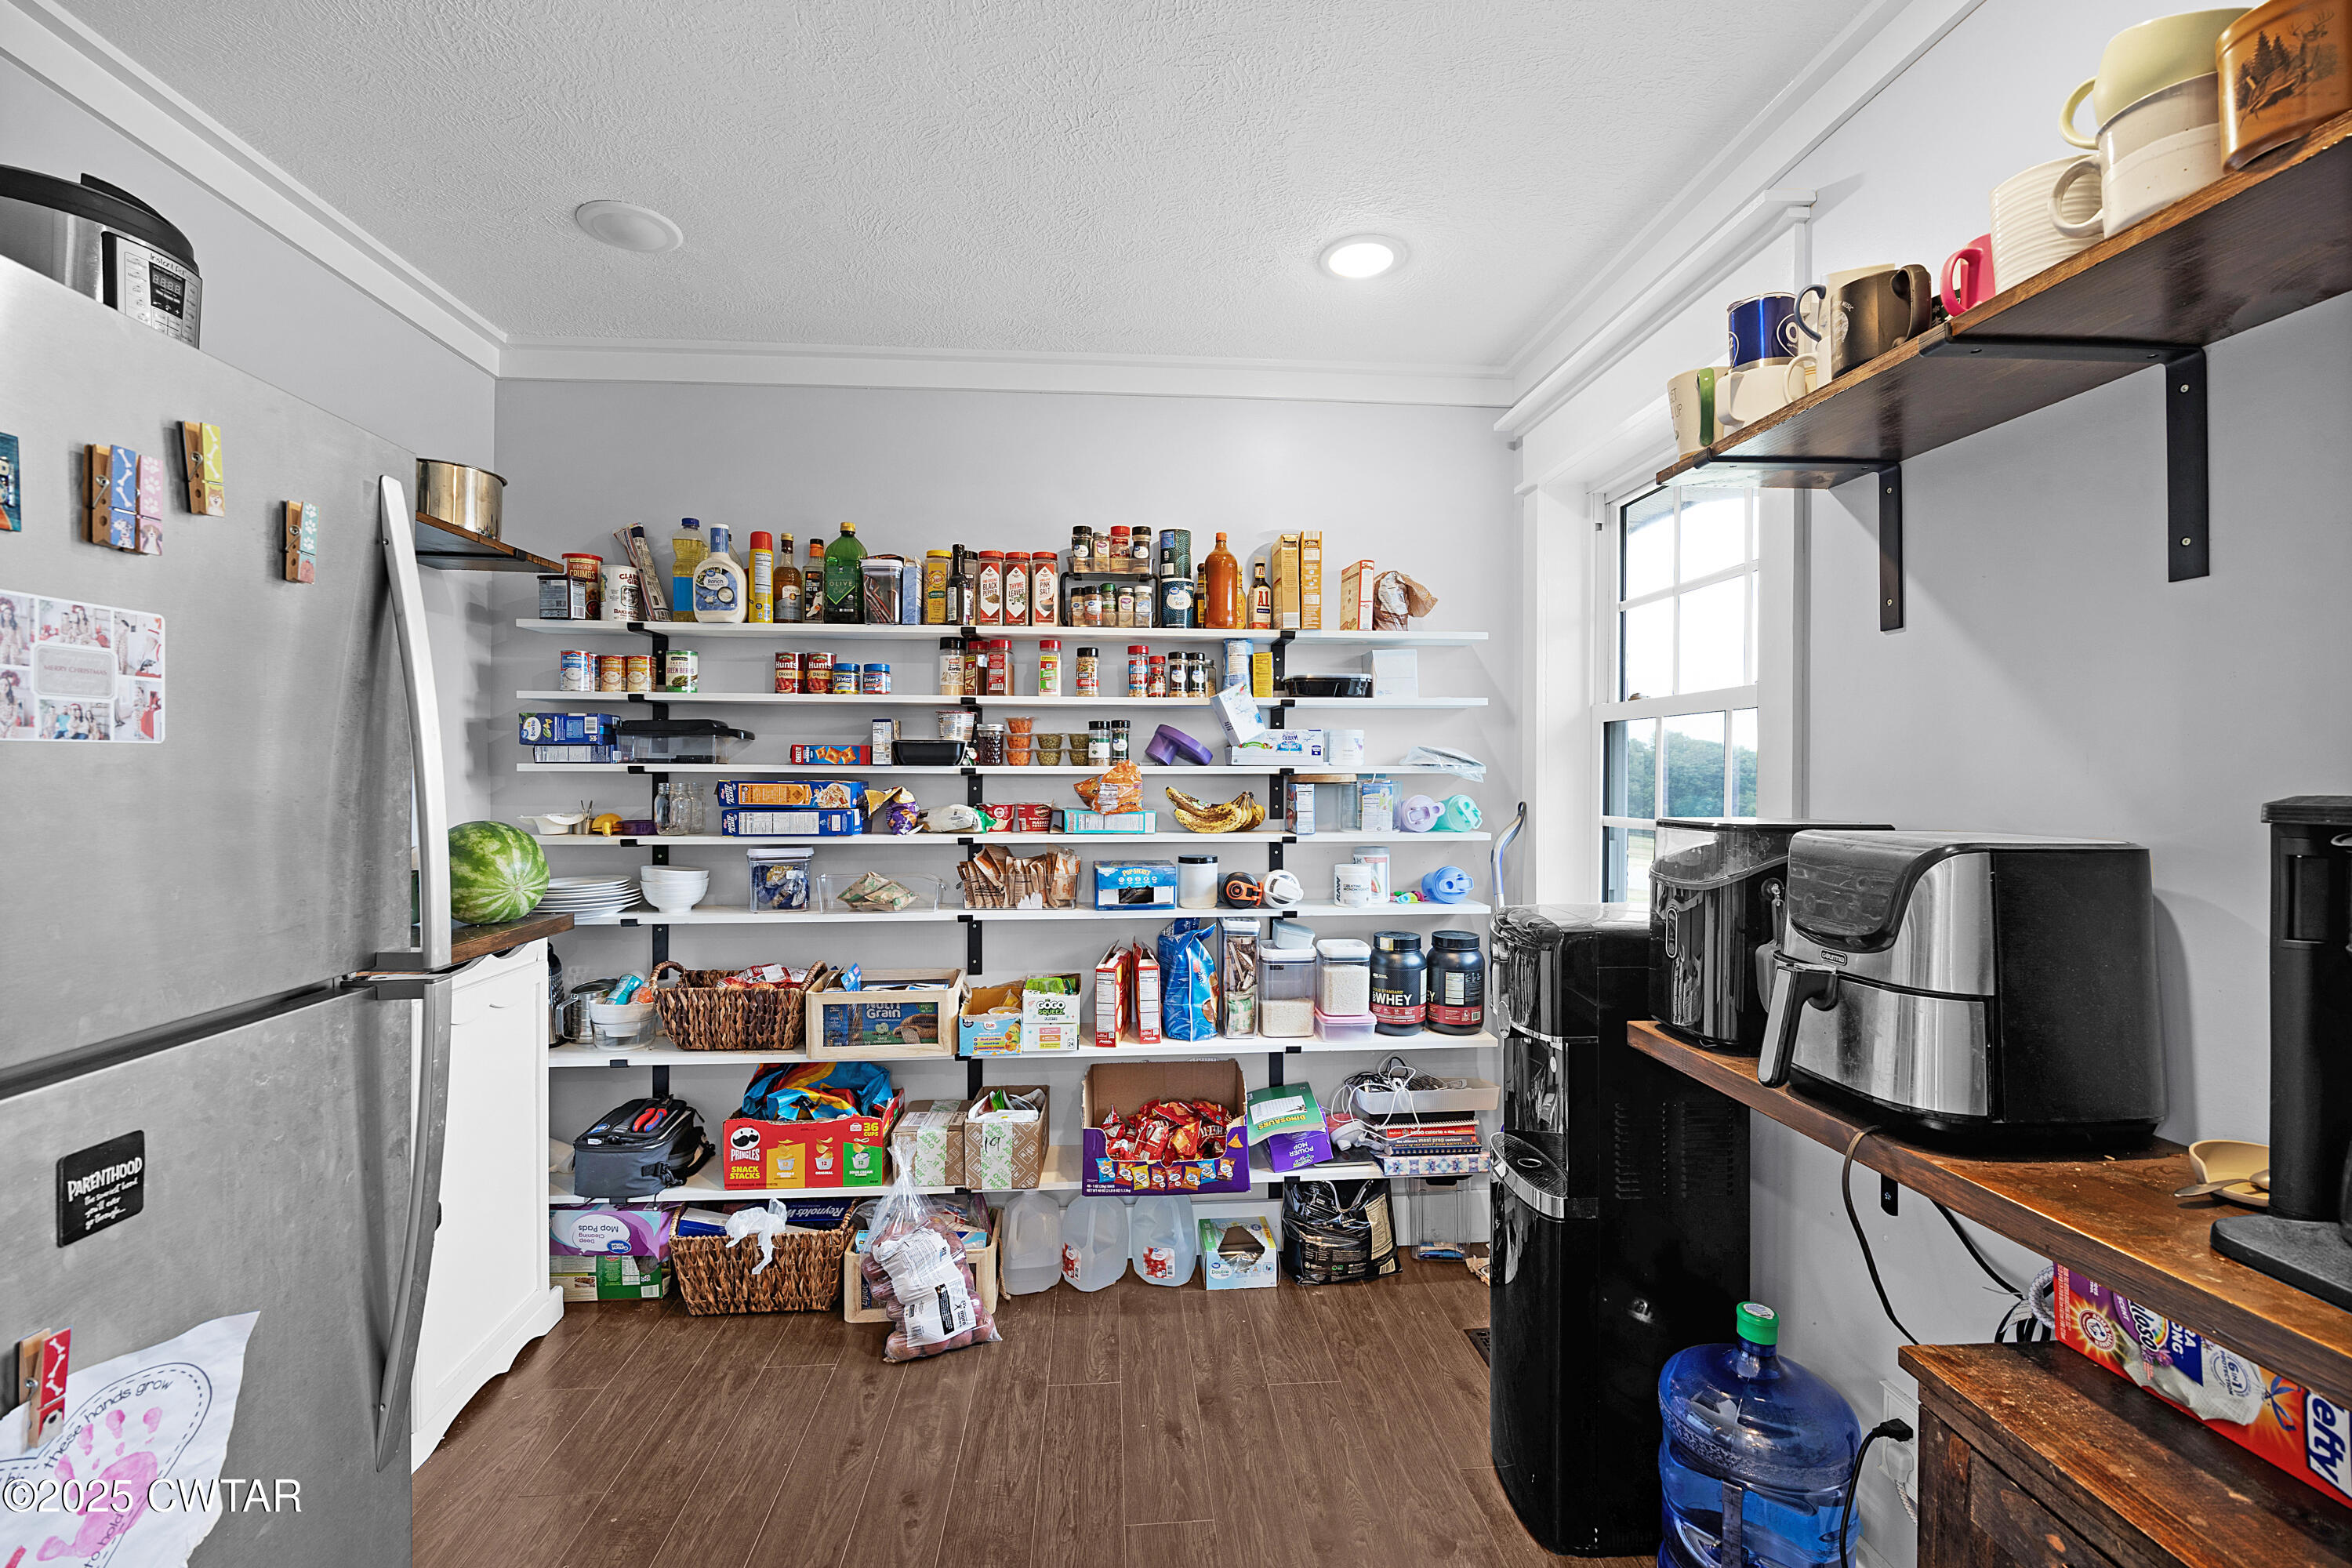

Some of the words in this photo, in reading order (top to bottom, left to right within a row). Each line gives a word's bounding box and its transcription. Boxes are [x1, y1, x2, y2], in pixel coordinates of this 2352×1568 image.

[569, 570, 595, 579] CRUMBS
[44, 664, 67, 673] MERRY
[68, 666, 107, 676] CHRISTMAS
[1376, 993, 1412, 1006] WHEY
[866, 1008, 901, 1018] Grain
[863, 1122, 879, 1132] 36
[1258, 1115, 1306, 1130] DINOSAURS
[731, 1148, 760, 1162] PRINGLES
[1289, 1146, 1314, 1156] POWER
[67, 1157, 143, 1202] PARENTHOOD
[993, 1173, 1009, 1187] over
[796, 1207, 844, 1217] Reynolds
[2117, 1295, 2130, 1322] SCENT
[2220, 1350, 2234, 1396] PROTECTION
[2228, 1362, 2239, 1372] 6
[2232, 1373, 2238, 1381] IN
[44, 1424, 83, 1470] these
[84, 1387, 132, 1425] hands
[136, 1377, 174, 1397] grow
[2310, 1398, 2346, 1484] efty
[97, 1512, 125, 1546] hold
